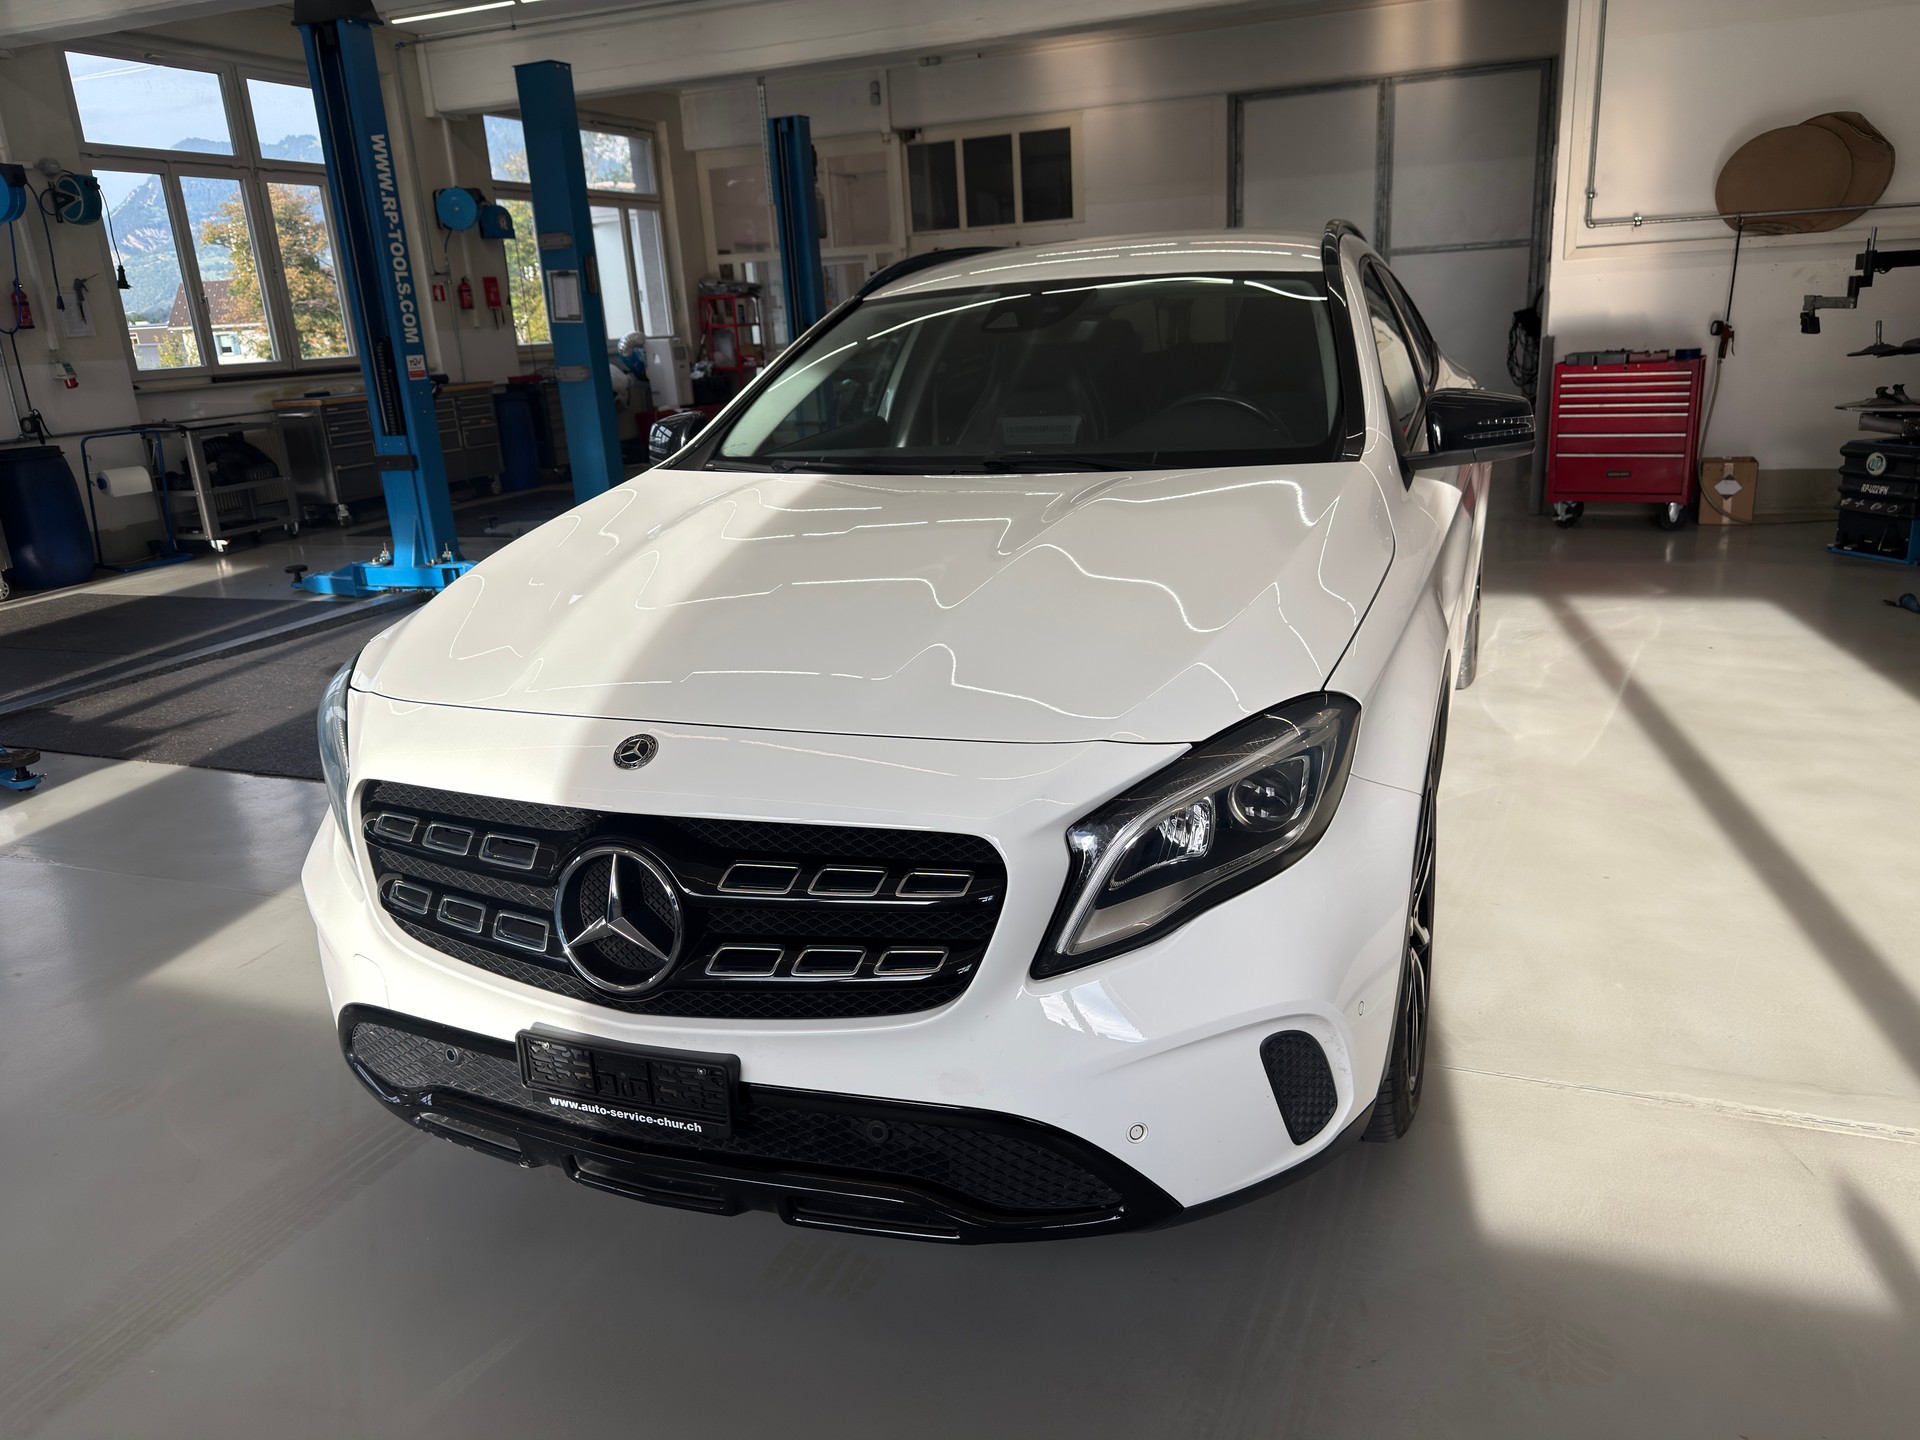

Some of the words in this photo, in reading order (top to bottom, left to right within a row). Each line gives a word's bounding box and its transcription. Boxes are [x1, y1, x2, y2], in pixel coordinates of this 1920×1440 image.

[371, 133, 419, 344] WWW.RP-TOOLS.COM
[409, 358, 423, 366] TÜV
[549, 1096, 702, 1133] www.auto-service-chur.ch
